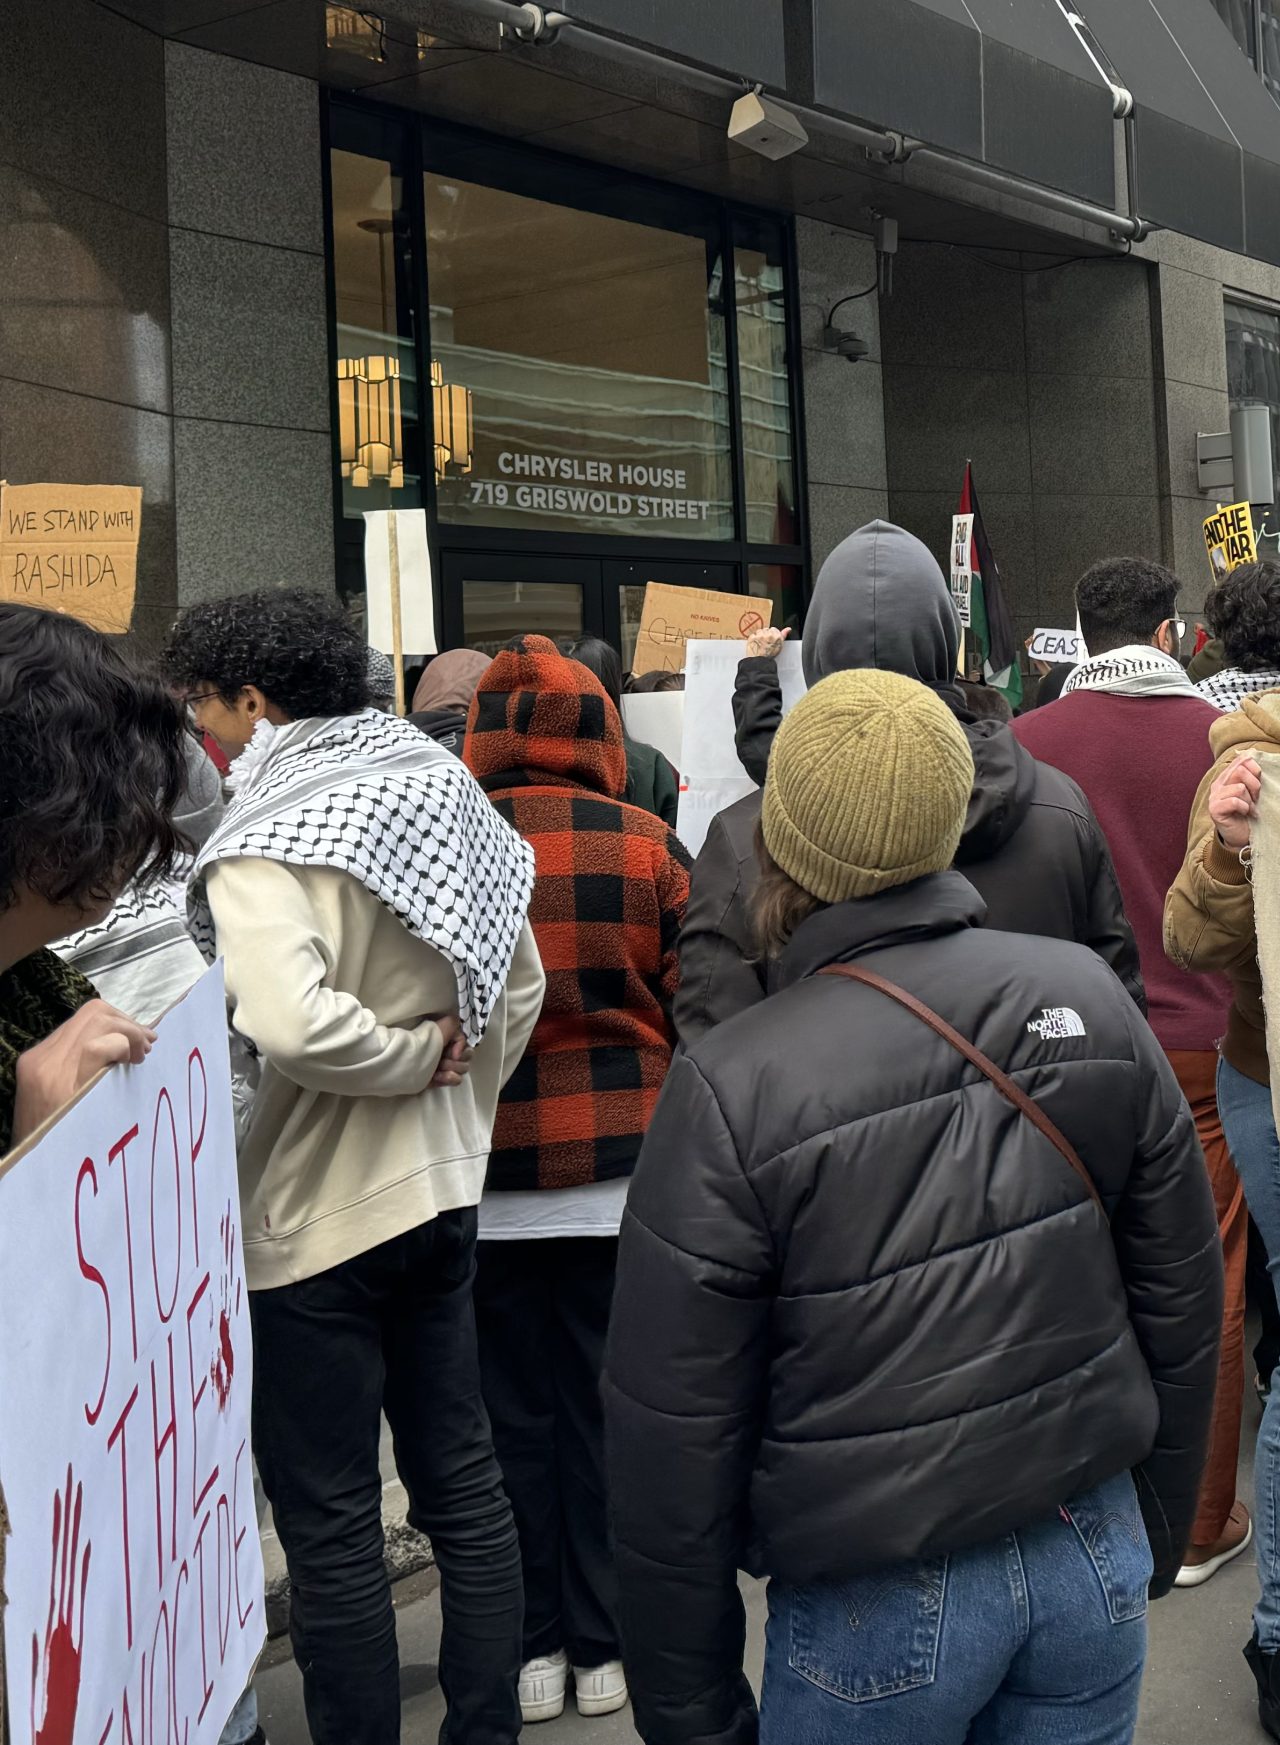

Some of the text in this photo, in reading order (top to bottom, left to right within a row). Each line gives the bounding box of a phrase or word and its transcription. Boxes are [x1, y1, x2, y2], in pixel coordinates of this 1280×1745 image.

[498, 451, 687, 489] CHRYSLER HOUSE
[470, 482, 709, 520] 719 GRISWOLD STREET
[9, 509, 133, 535] WE STAND WITH
[13, 552, 118, 597] RASHIDA
[700, 614, 720, 623] KNIVES
[1031, 632, 1079, 656] CEAS
[1027, 1018, 1065, 1032] NORTH
[1041, 1007, 1064, 1019] THE
[1040, 1028, 1068, 1040] FACE
[74, 1046, 208, 1427] STOP
[107, 1271, 220, 1651] THE
